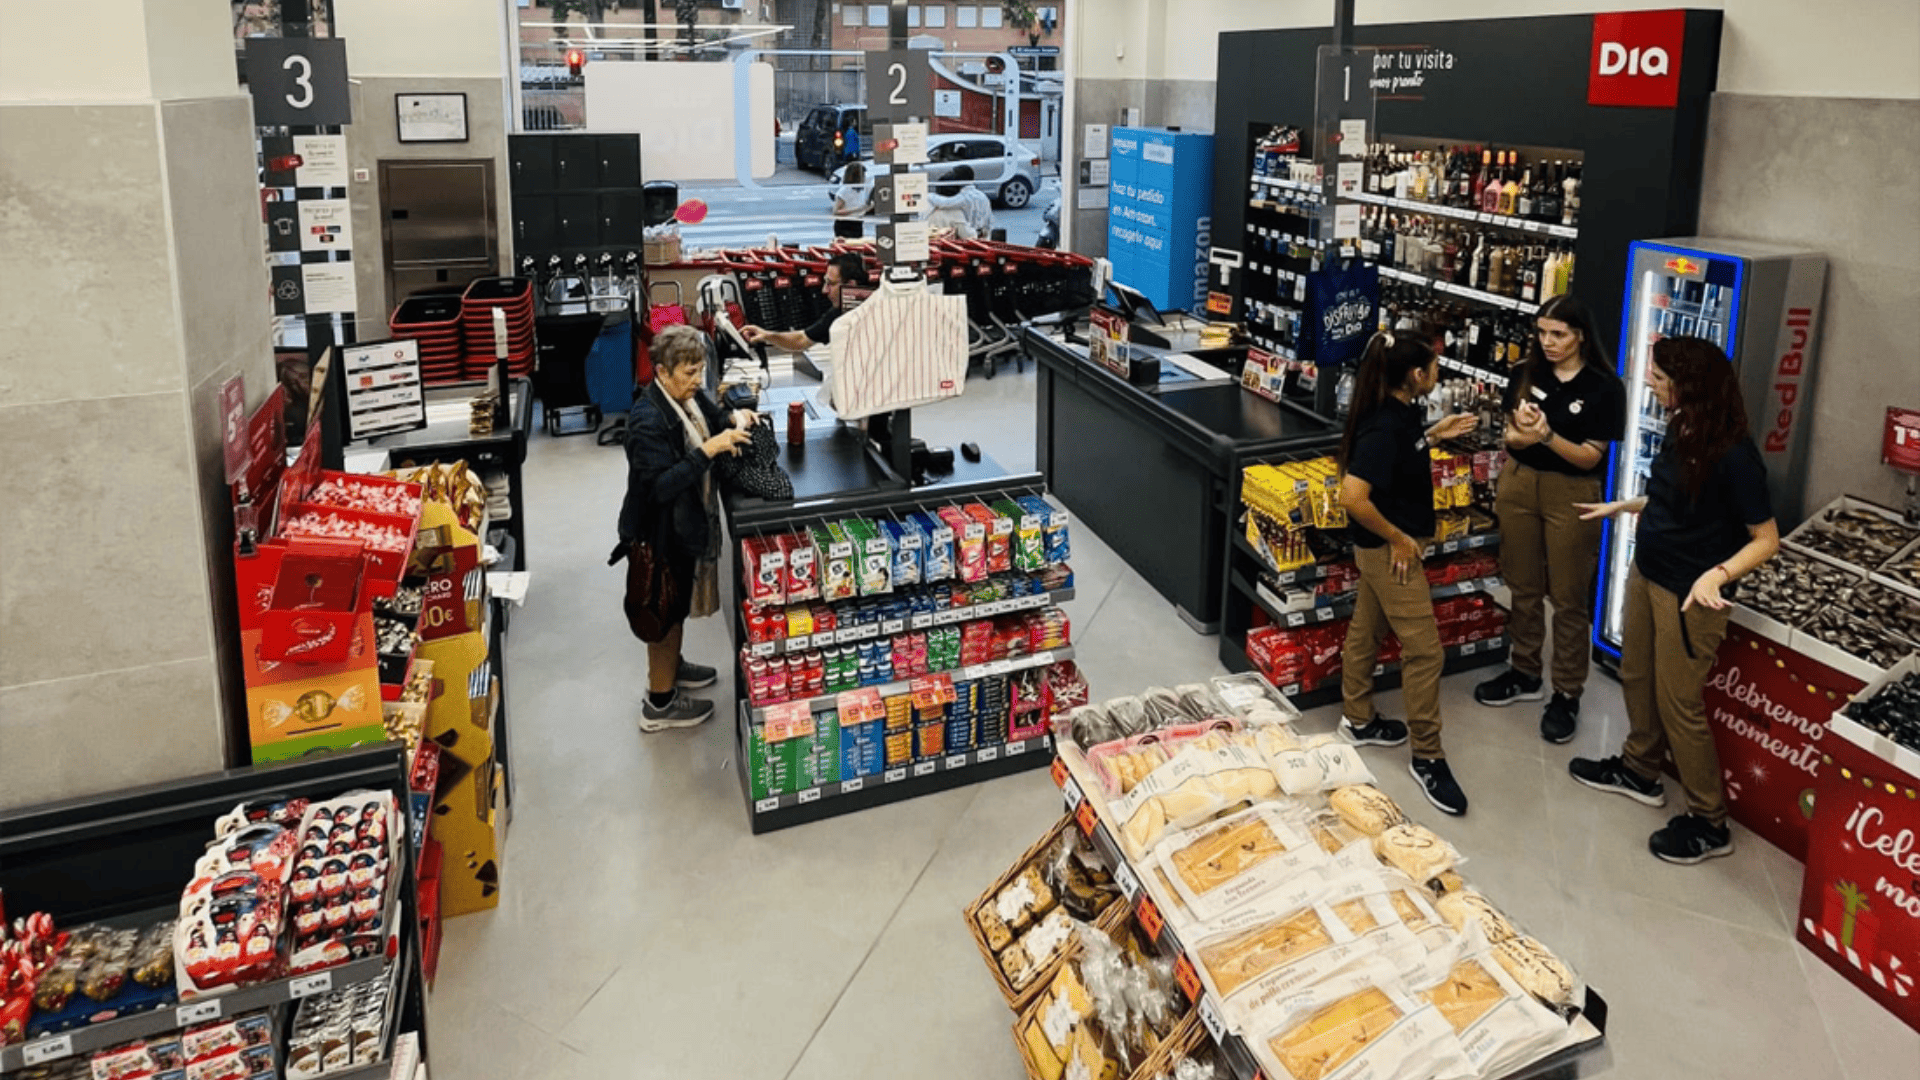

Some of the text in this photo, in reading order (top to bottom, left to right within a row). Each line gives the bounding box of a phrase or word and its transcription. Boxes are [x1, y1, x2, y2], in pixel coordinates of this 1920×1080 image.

[282, 54, 314, 108] 3
[887, 62, 908, 105] 2
[1373, 49, 1454, 73] por tu visita
[1764, 307, 1812, 453] Red Bull
[1704, 666, 1825, 741] elebremo
